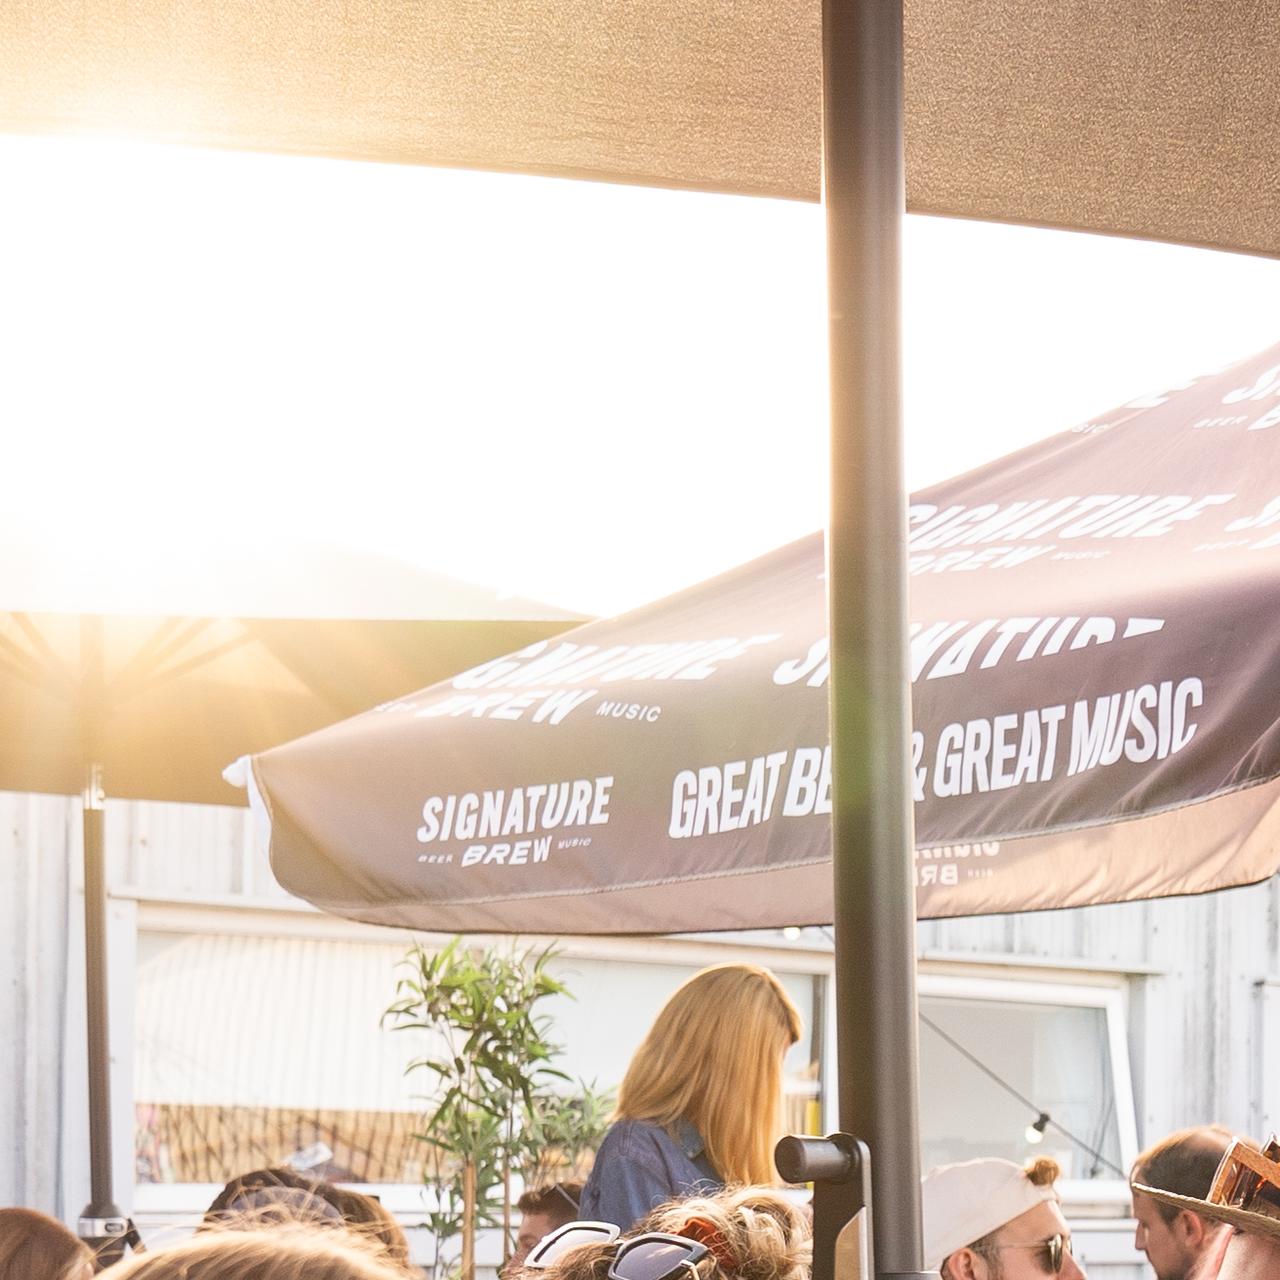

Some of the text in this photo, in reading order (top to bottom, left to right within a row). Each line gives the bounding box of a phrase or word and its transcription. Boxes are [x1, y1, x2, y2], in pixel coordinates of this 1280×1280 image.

[595, 701, 662, 722] MUSIC
[668, 749, 788, 838] GREAT
[785, 747, 834, 818] BE
[932, 702, 1066, 799] GREAT
[1066, 676, 1204, 778] MUSIC
[416, 776, 614, 843] SIGNATURE
[460, 835, 553, 868] BREW
